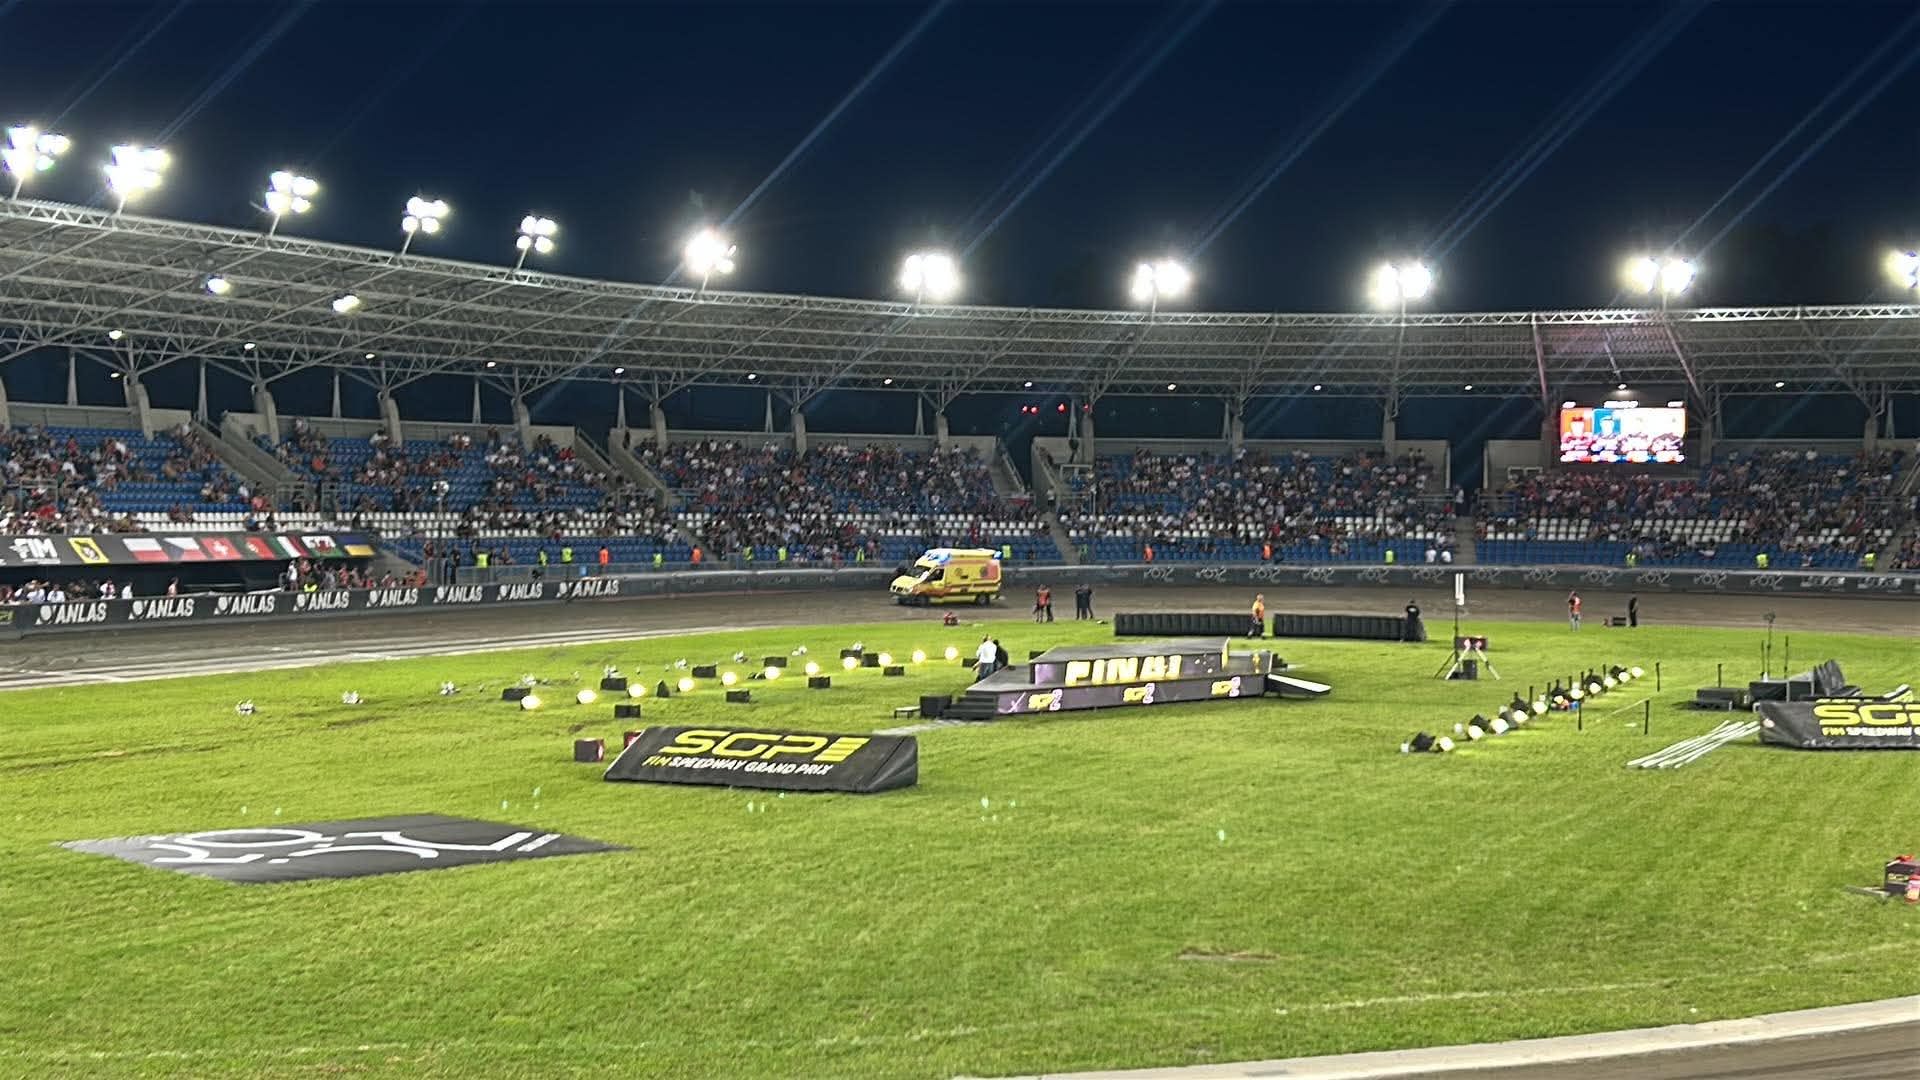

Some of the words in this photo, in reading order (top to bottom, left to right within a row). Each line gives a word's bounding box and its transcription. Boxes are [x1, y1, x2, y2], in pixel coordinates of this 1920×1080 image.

[13, 538, 58, 559] FIM
[380, 588, 419, 607] ANLAS
[447, 585, 483, 603] ANLAS
[572, 579, 619, 598] ANLAS
[147, 598, 195, 619] ANLAS
[231, 595, 275, 615] ANLAS
[308, 592, 350, 611] ANLAS
[55, 602, 107, 625] ANLAS
[641, 755, 671, 768] FIM
[669, 756, 747, 771] SPEEDWAY
[743, 761, 796, 775] GRAND
[794, 763, 834, 776] PRIX
